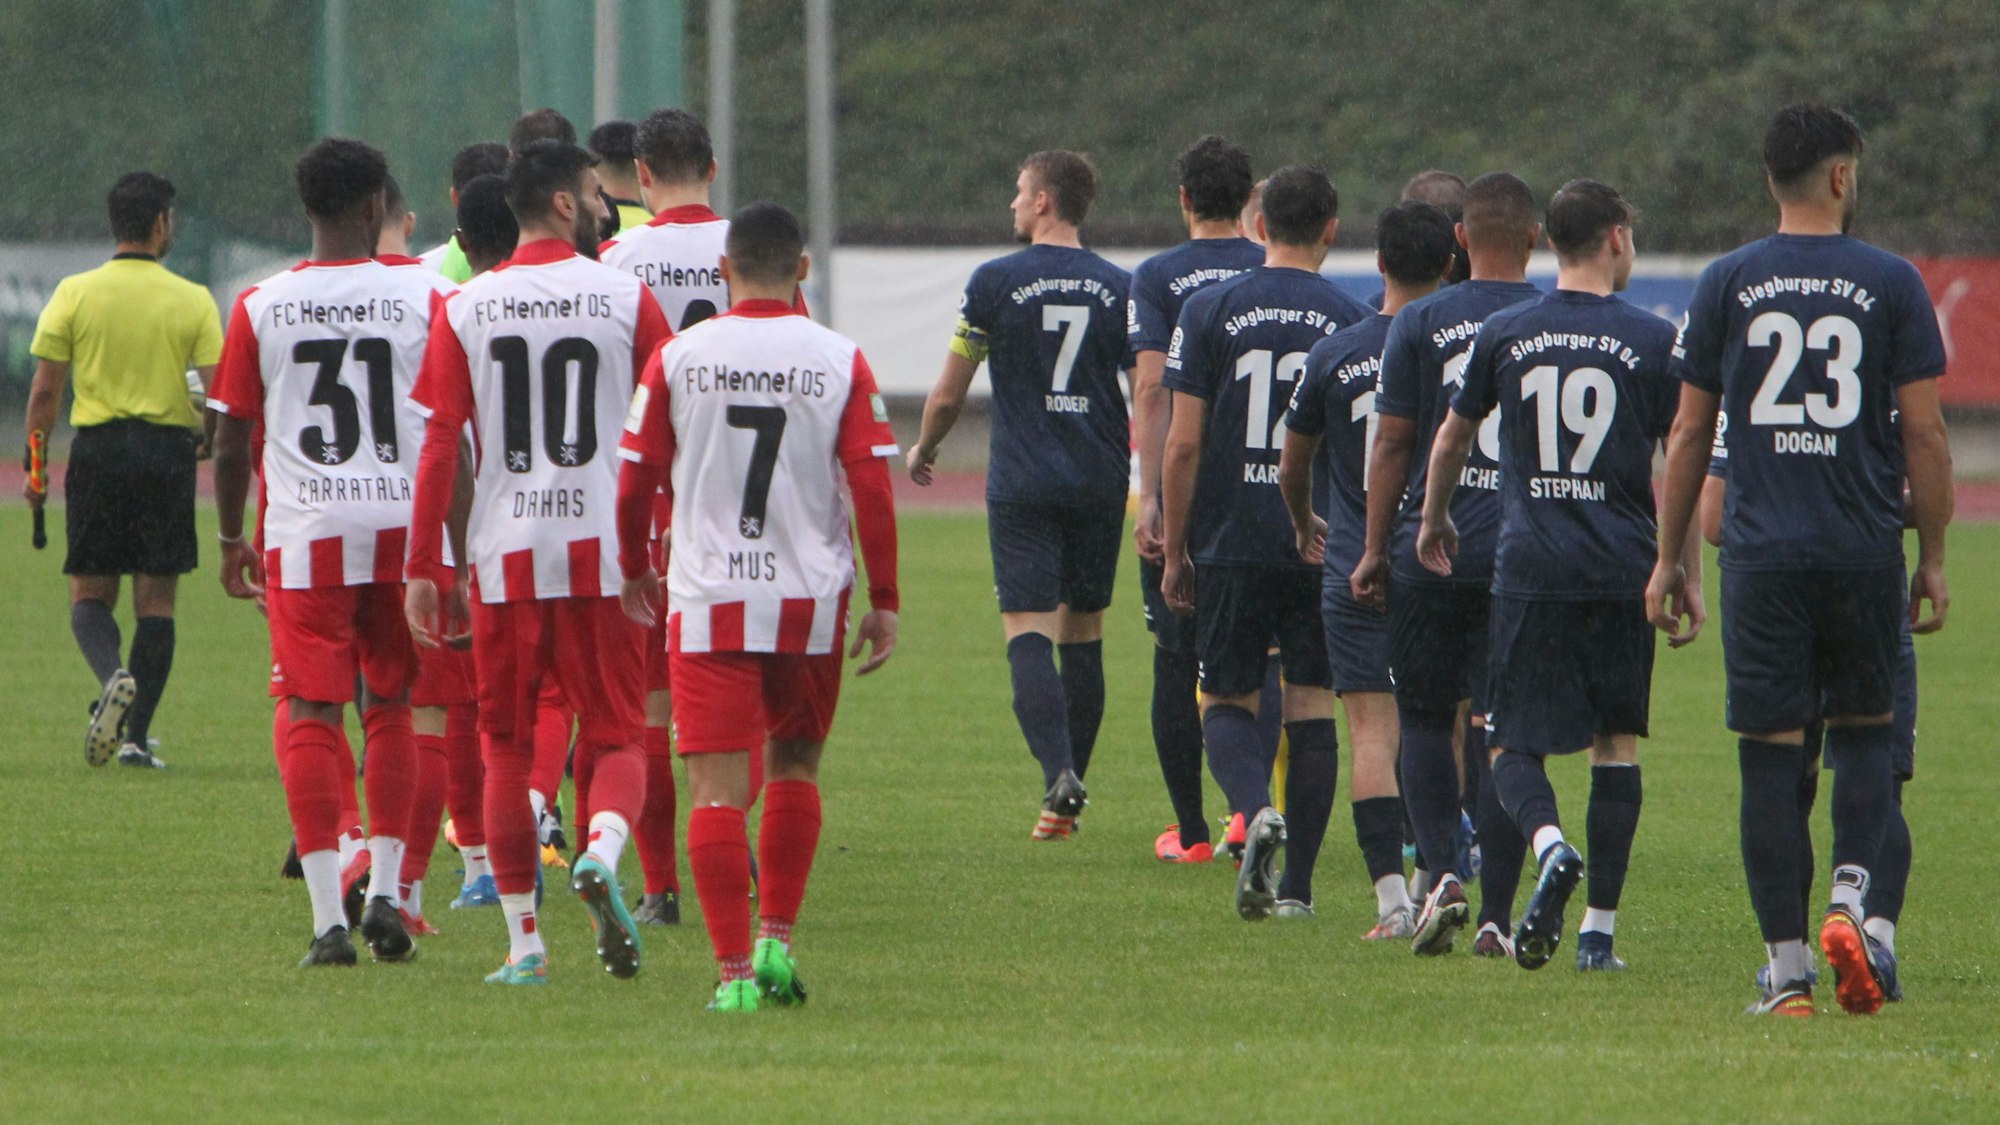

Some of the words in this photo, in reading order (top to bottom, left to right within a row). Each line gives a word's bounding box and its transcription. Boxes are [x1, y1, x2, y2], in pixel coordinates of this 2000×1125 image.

[1011, 278, 1082, 304] Siegburger
[1083, 278, 1102, 295] SV
[1100, 288, 1117, 307] 04
[1738, 275, 1829, 308] Siegburger
[1831, 278, 1855, 298] SV
[1853, 288, 1876, 312] 04
[273, 303, 295, 328] FC
[300, 299, 375, 323] Hennef
[381, 299, 404, 322] 05
[475, 300, 497, 326] FC
[503, 293, 581, 319] Hennef
[588, 293, 611, 318] 05
[1225, 306, 1304, 336] Siegburger
[1305, 310, 1328, 329] SV
[1042, 304, 1089, 392] 7
[1510, 331, 1597, 361] Siegburger
[1598, 335, 1622, 355] SV
[1619, 346, 1640, 370] 04
[686, 367, 708, 394] FC
[714, 364, 796, 393] Hennef
[801, 369, 825, 397] 05
[1747, 311, 1863, 429] 23
[293, 337, 398, 466] 31
[490, 335, 598, 473] 10
[1044, 394, 1089, 413] RODER
[1520, 365, 1617, 474] 19
[1774, 431, 1837, 456] DOGAN
[726, 404, 787, 539] 7
[1243, 463, 1280, 484] KAR
[1456, 465, 1499, 490] ICHE
[298, 476, 412, 503] CARRATALA
[513, 488, 584, 518] DAHAS
[1530, 477, 1605, 501] STEPHAN
[728, 552, 776, 581] MUS
